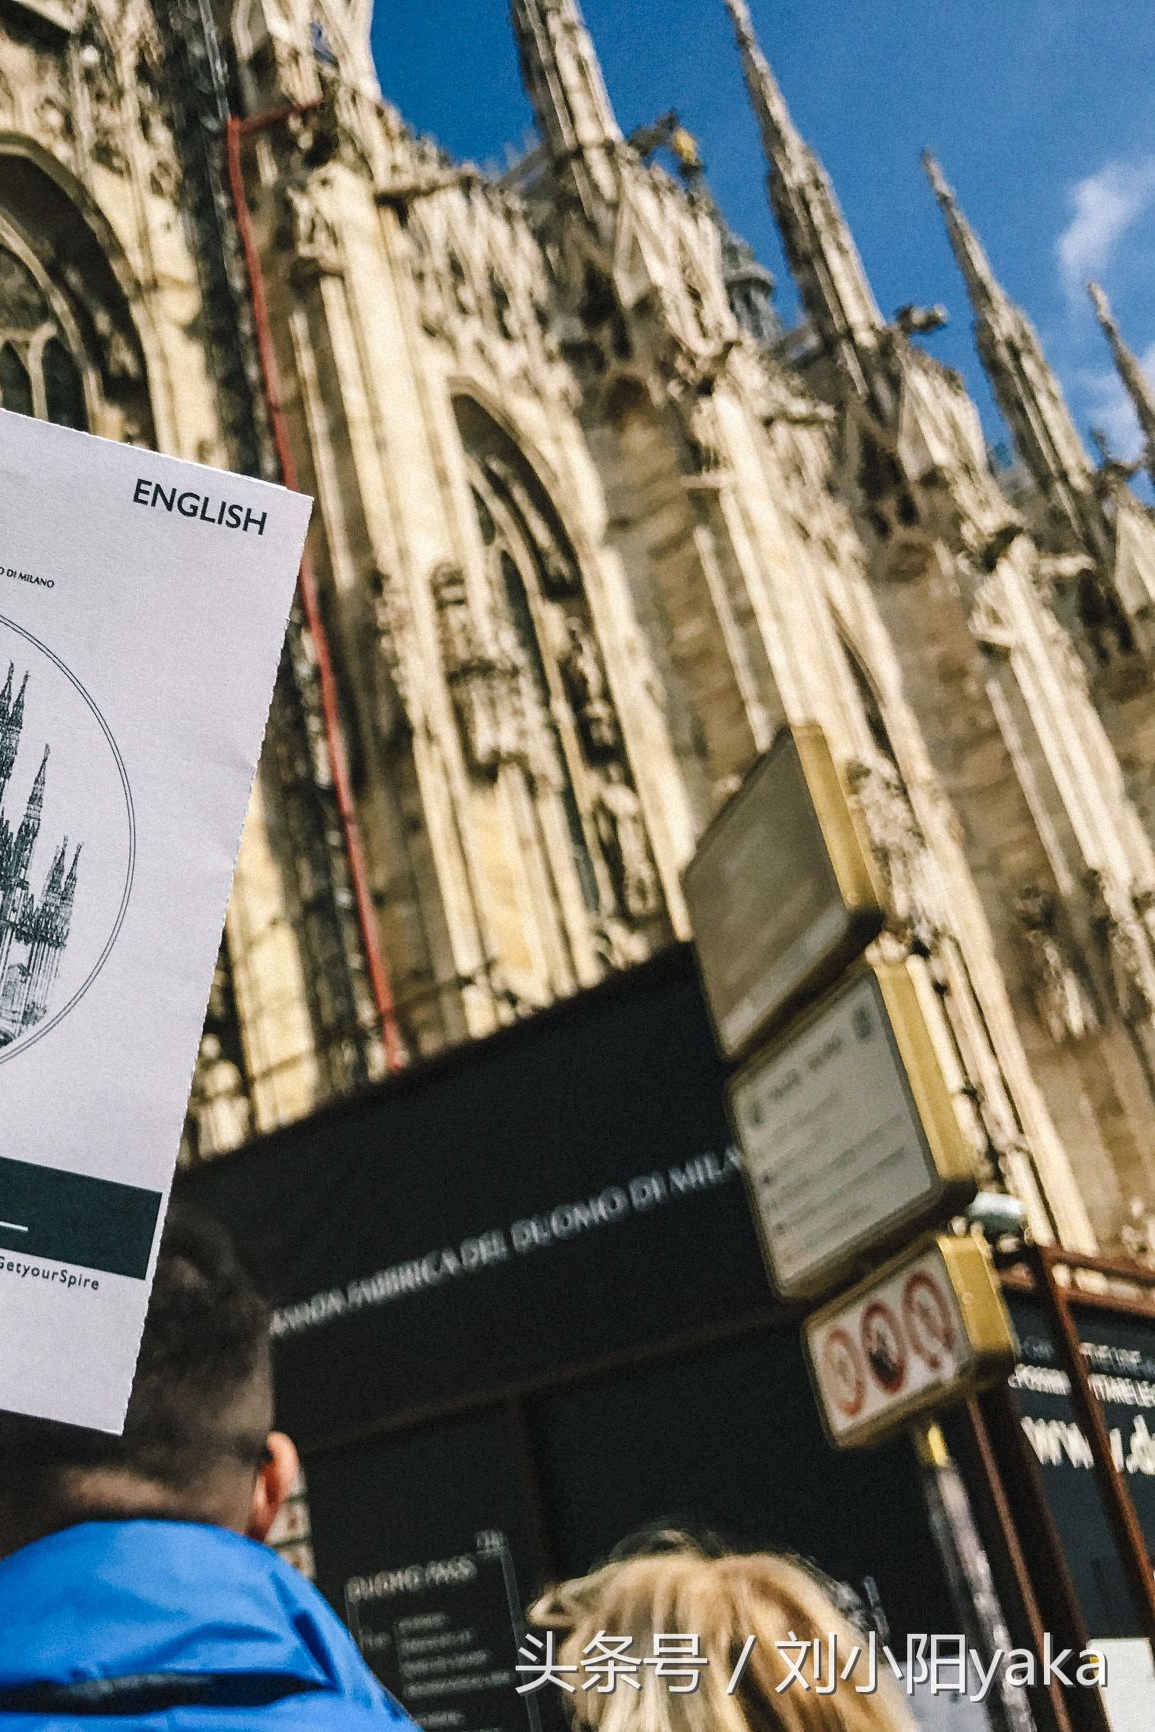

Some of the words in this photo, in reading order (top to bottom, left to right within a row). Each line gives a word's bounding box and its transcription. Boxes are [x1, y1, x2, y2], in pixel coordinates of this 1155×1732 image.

[133, 478, 268, 536] ENGLISH
[6, 568, 17, 578] DI
[18, 572, 55, 588] MILANO
